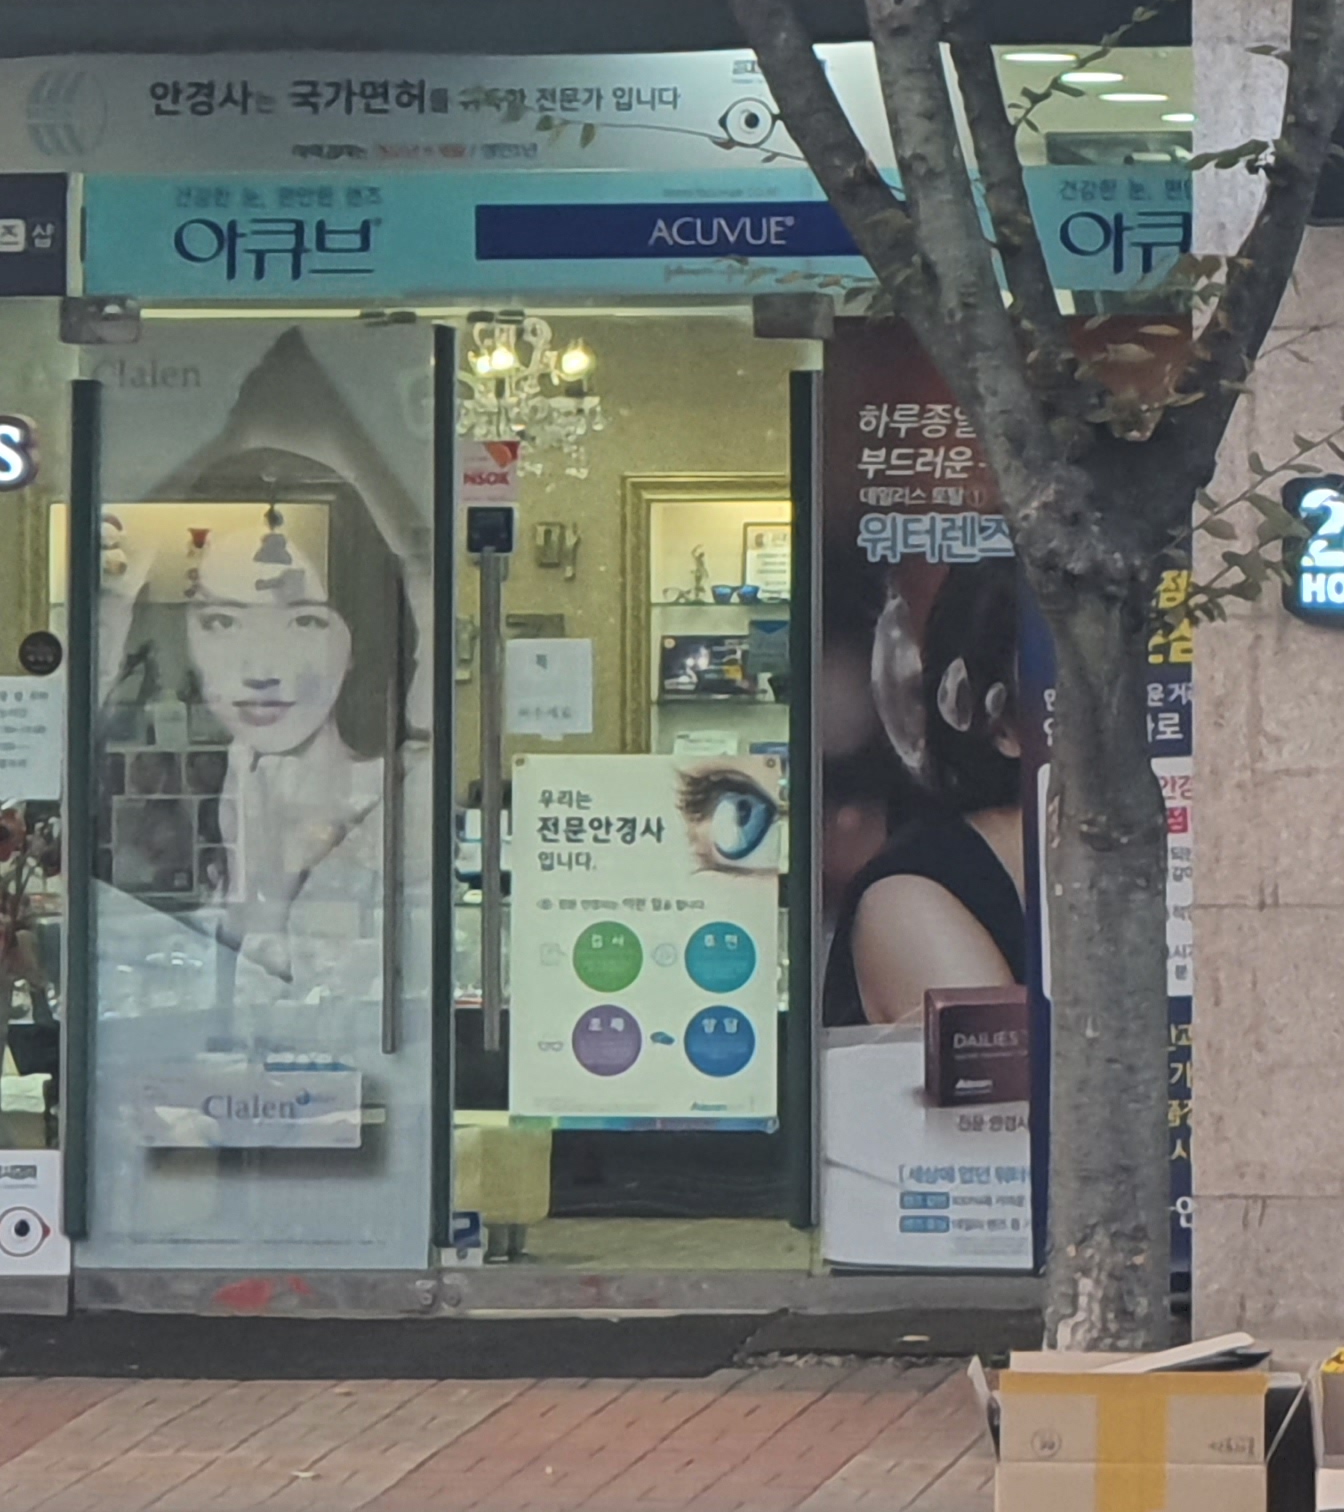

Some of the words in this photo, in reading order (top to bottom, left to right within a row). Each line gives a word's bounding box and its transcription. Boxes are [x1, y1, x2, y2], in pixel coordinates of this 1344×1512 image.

[535, 85, 605, 113] 전문가
[612, 85, 681, 113] 입니다
[647, 215, 790, 247] ACUVUE
[173, 217, 375, 281] 아큐브
[856, 445, 974, 480] 부드러운
[856, 511, 1016, 564] 워터렌즈
[538, 789, 593, 810] 우리는
[536, 815, 666, 845] 전문안경사
[952, 1032, 1019, 1049] DAILIES
[201, 1093, 297, 1121] Clalen
